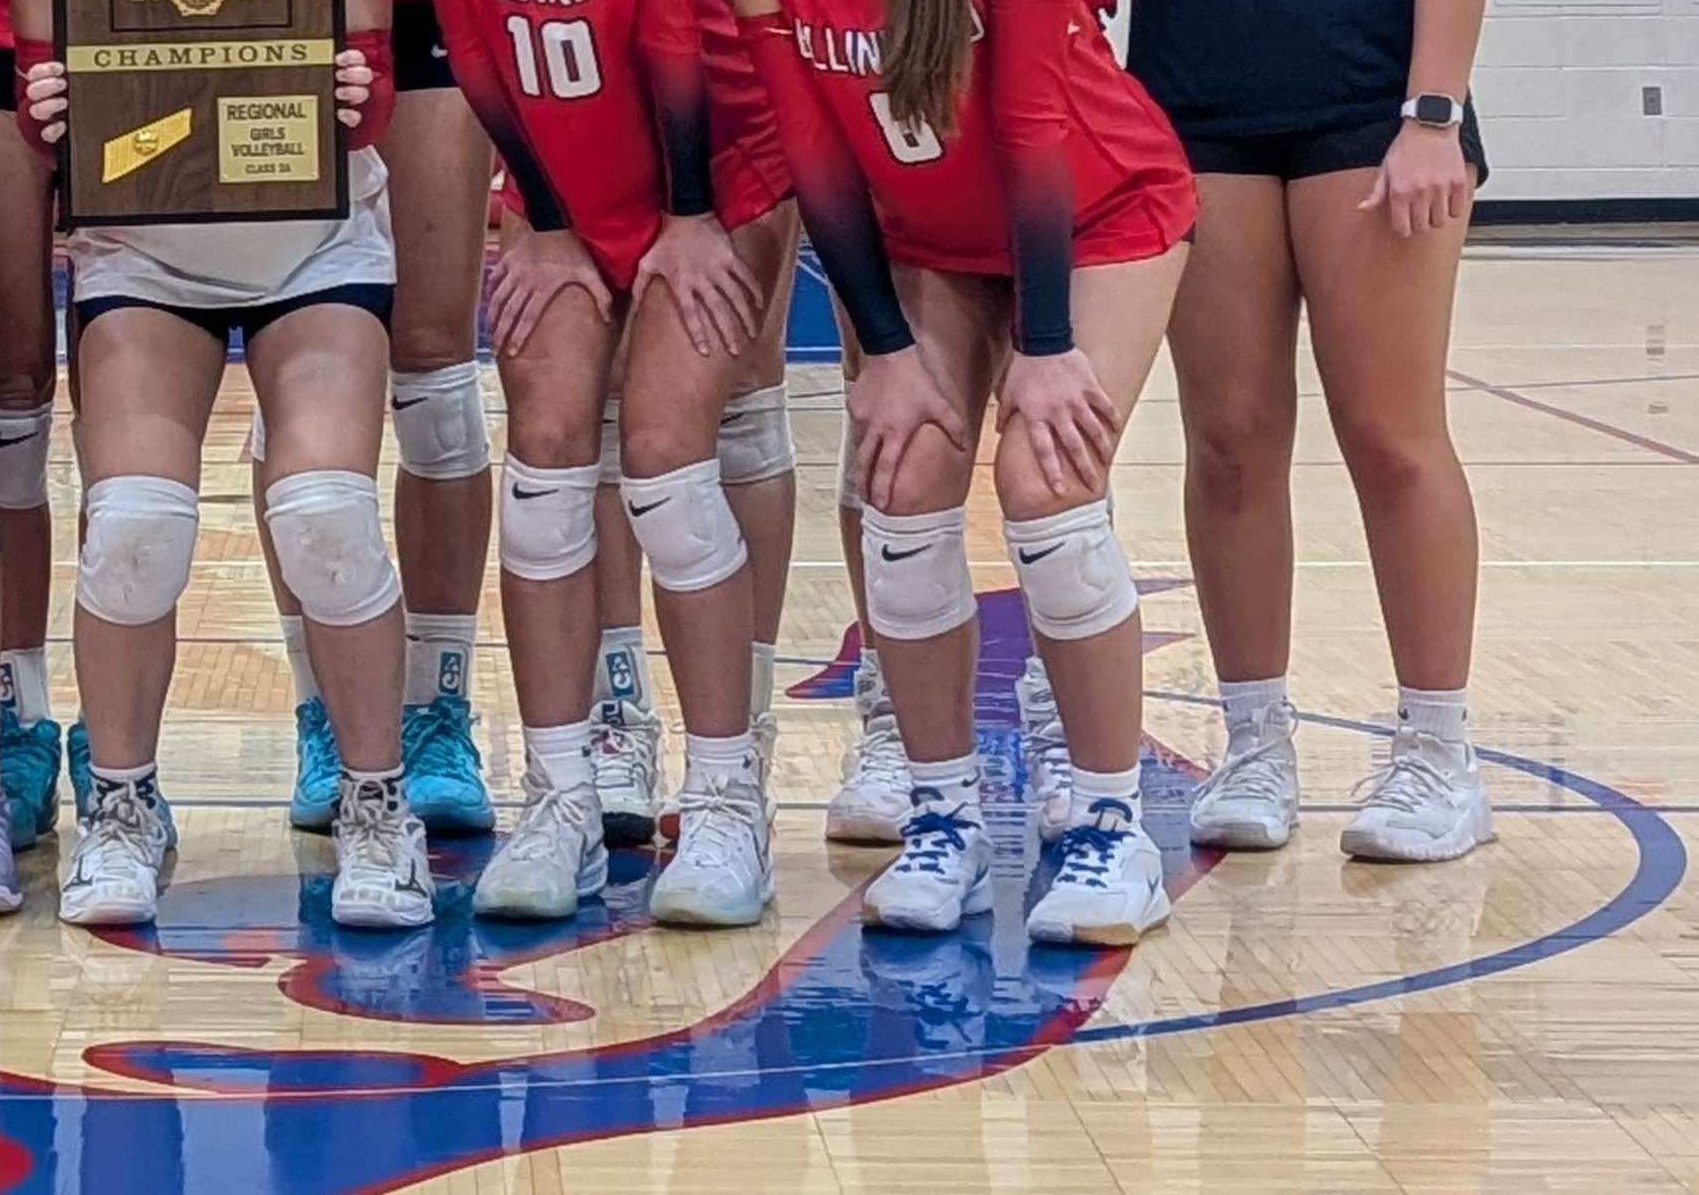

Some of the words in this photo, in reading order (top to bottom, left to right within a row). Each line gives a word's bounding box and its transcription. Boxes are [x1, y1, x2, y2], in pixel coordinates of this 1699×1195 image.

[93, 43, 309, 67] CHAMPIONS
[507, 15, 601, 98] 10
[227, 103, 307, 121] REGIONAL
[250, 127, 286, 141] GIRLS
[231, 142, 305, 157] VOLLEYBALL
